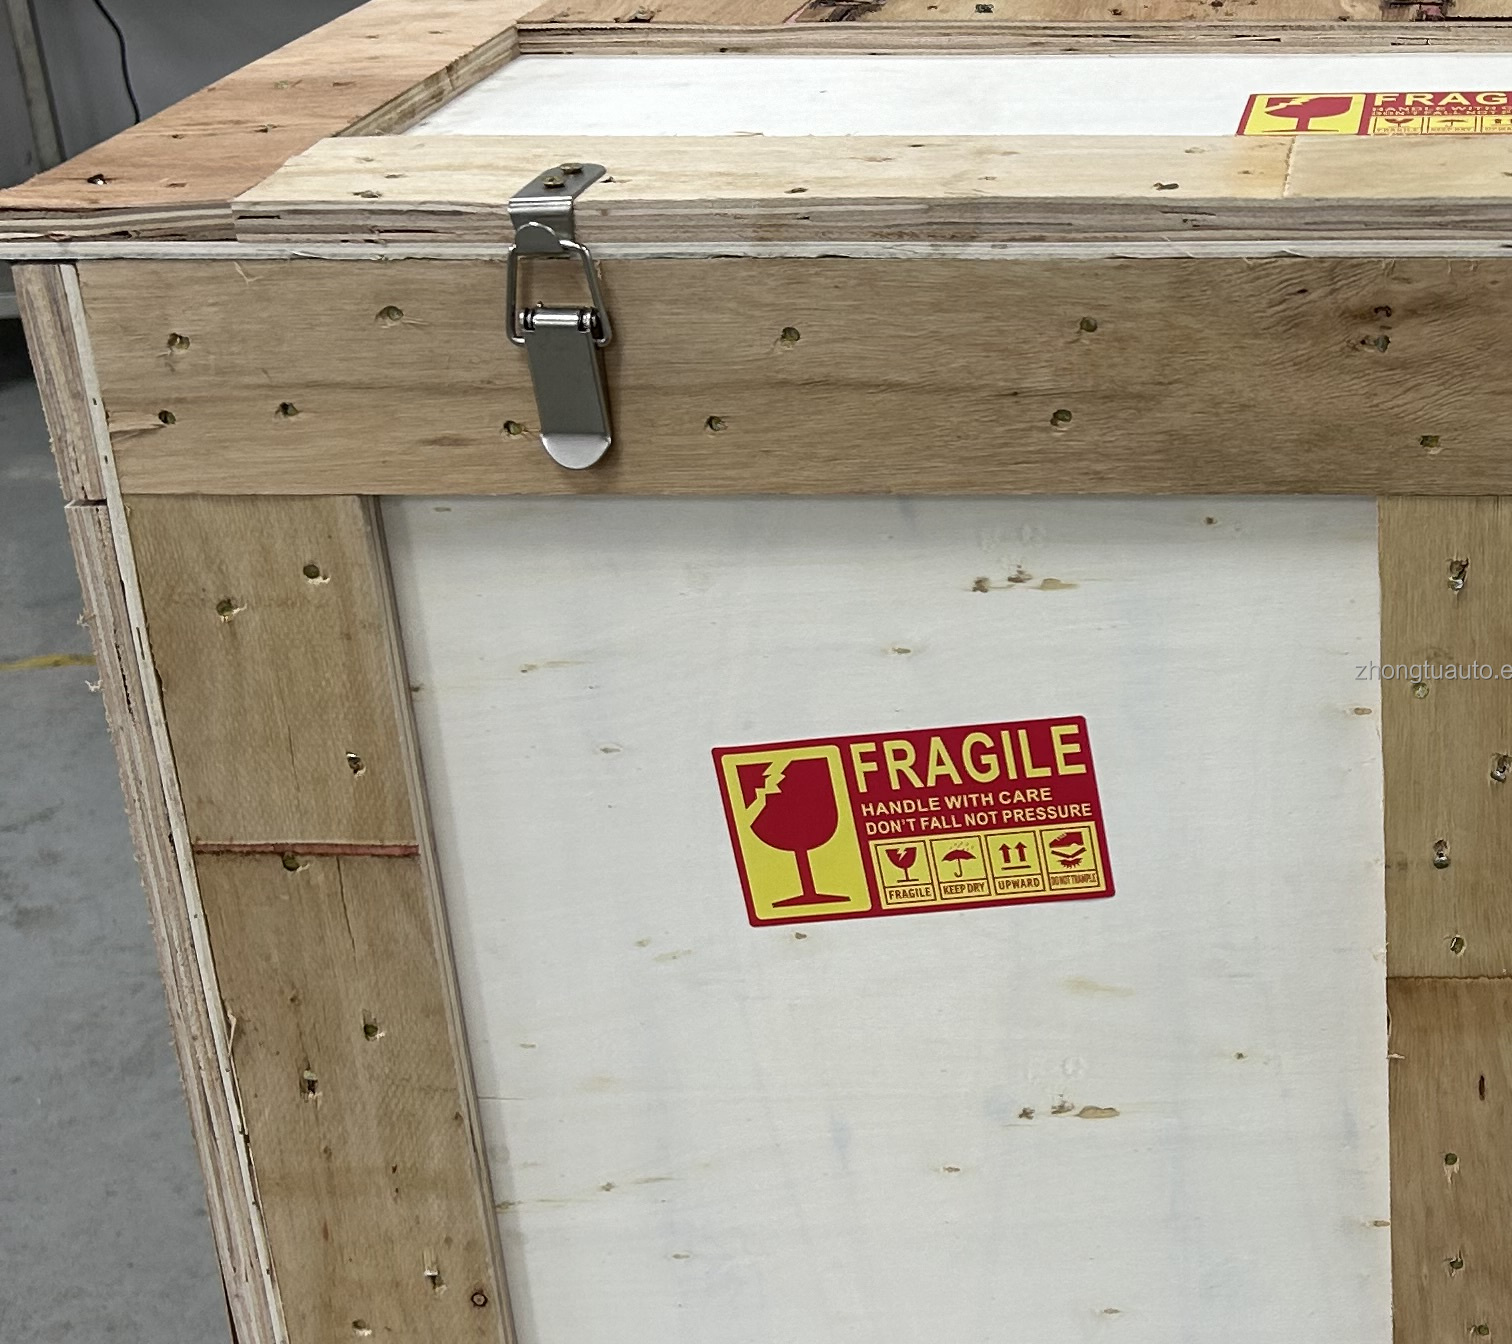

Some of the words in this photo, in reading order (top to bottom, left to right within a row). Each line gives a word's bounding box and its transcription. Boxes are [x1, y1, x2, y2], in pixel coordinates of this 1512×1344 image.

[850, 724, 1087, 793] FRAGILE
[861, 797, 940, 817] HANDLE
[944, 793, 994, 810] WITH
[998, 788, 1053, 804] CARE
[865, 819, 916, 835] DON'T
[920, 816, 962, 830] FALL
[965, 811, 998, 826] NOT
[1003, 803, 1092, 823] PRESSURE
[889, 887, 932, 900] FRAGILE
[943, 884, 966, 895] KEEP
[967, 882, 985, 893] DRY
[998, 877, 1040, 890] UPWARD
